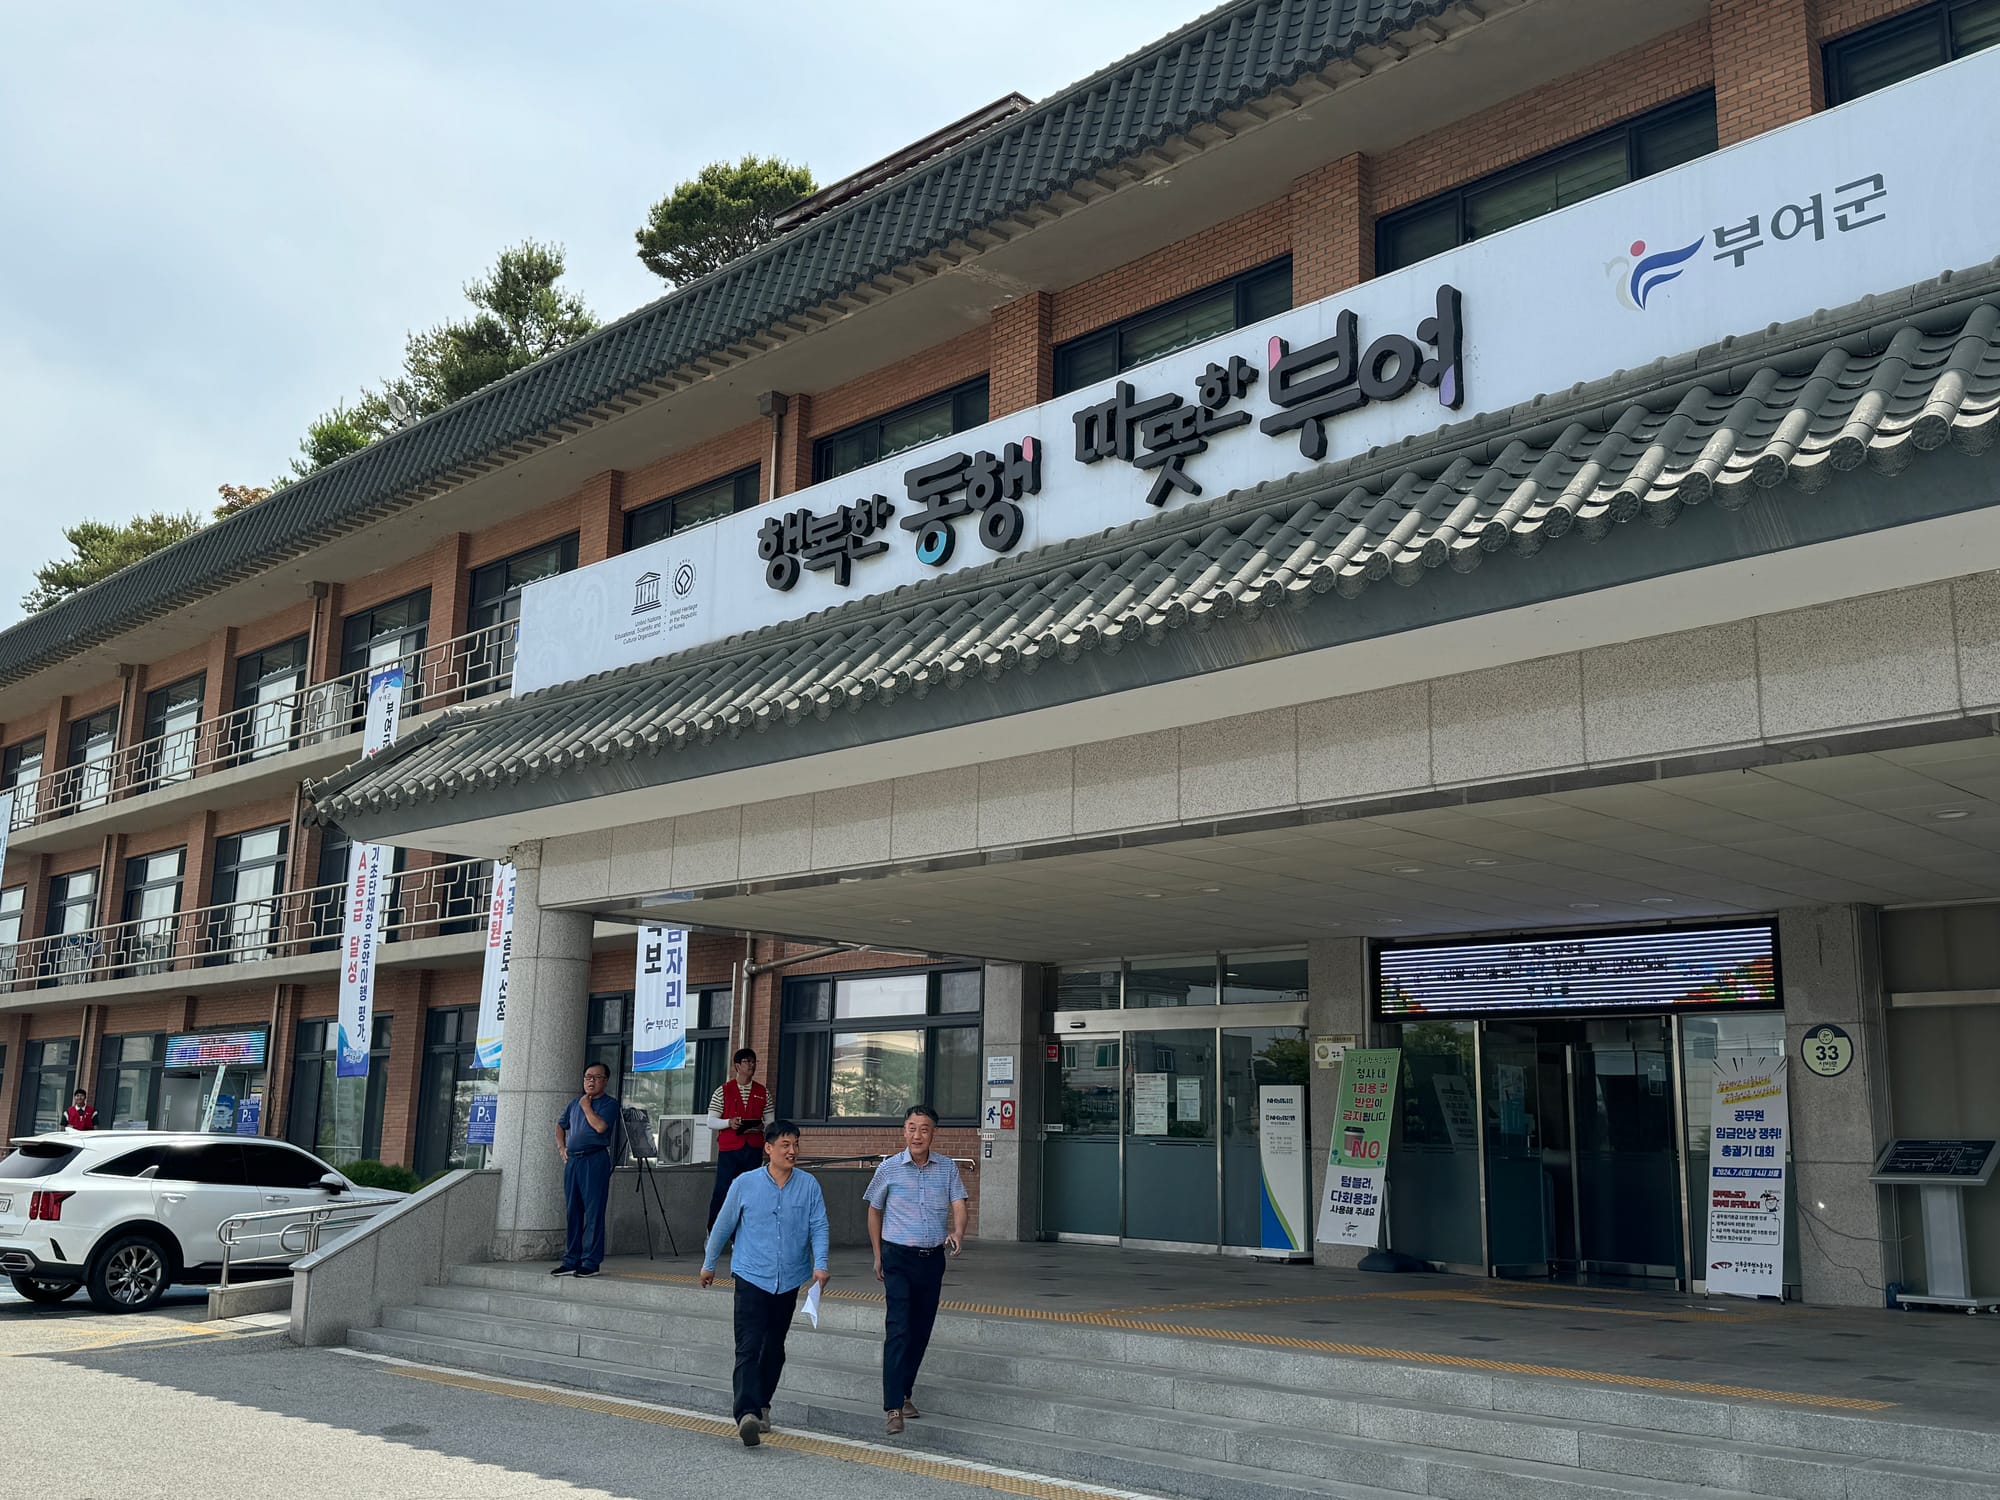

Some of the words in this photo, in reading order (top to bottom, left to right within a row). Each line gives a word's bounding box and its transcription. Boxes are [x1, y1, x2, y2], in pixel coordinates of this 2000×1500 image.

[1712, 173, 1887, 268] 부여군
[757, 494, 896, 592] 행복한
[900, 435, 1042, 566] 동행
[1074, 354, 1259, 508] 따뜻한
[1260, 283, 1464, 461] 부여
[655, 1018, 679, 1030] 부여군
[1815, 1045, 1839, 1061] 33
[1356, 1068, 1375, 1079] 청사
[1377, 1068, 1386, 1079] 내
[1352, 1082, 1377, 1094] 1회용
[1379, 1082, 1388, 1094] 컵
[1354, 1097, 1382, 1109] 반입이
[241, 1110, 248, 1122] P
[477, 1106, 485, 1122] P
[1734, 1110, 1765, 1122] 공무원
[1716, 1127, 1757, 1140] 임금인상
[1759, 1127, 1782, 1140] 쟁취!
[1351, 1138, 1381, 1160] NO
[1721, 1145, 1752, 1157] 총궐기
[1755, 1145, 1775, 1157] 대회
[1341, 1175, 1374, 1191] 텀블러,
[1330, 1204, 1353, 1215] 사용해
[1355, 1207, 1375, 1217] 주세요
